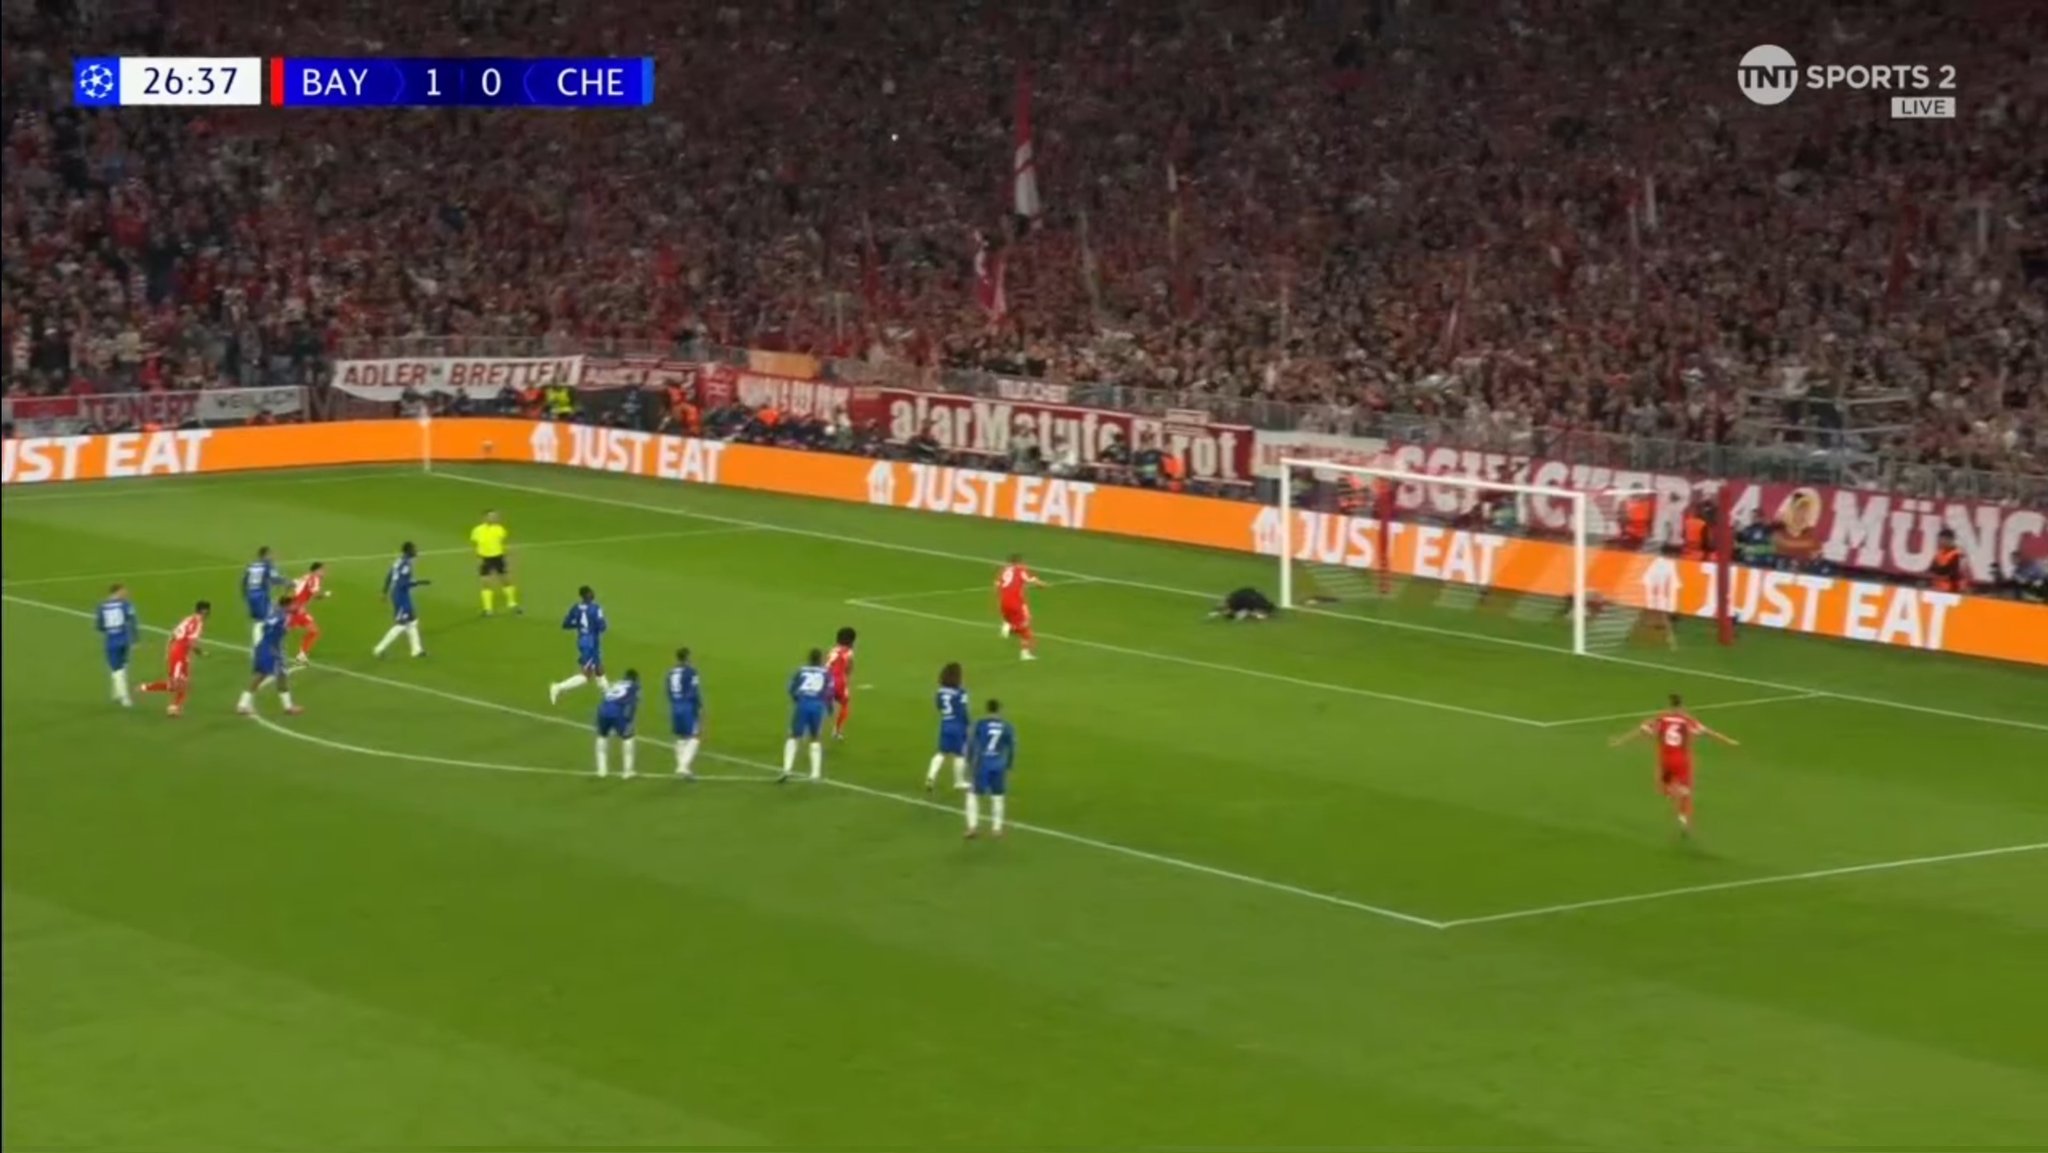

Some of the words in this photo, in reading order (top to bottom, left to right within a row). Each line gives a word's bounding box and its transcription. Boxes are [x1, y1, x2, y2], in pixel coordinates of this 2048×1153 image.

[105, 429, 213, 478] EAT
[567, 423, 656, 475] JUST
[657, 434, 727, 484] EAT
[907, 463, 1008, 518] JUST
[1013, 475, 1097, 529] EAT
[1413, 525, 1508, 585] EAT
[1844, 578, 1961, 650] EAT
[988, 729, 1003, 751] 7
[1665, 723, 1683, 747] 6
